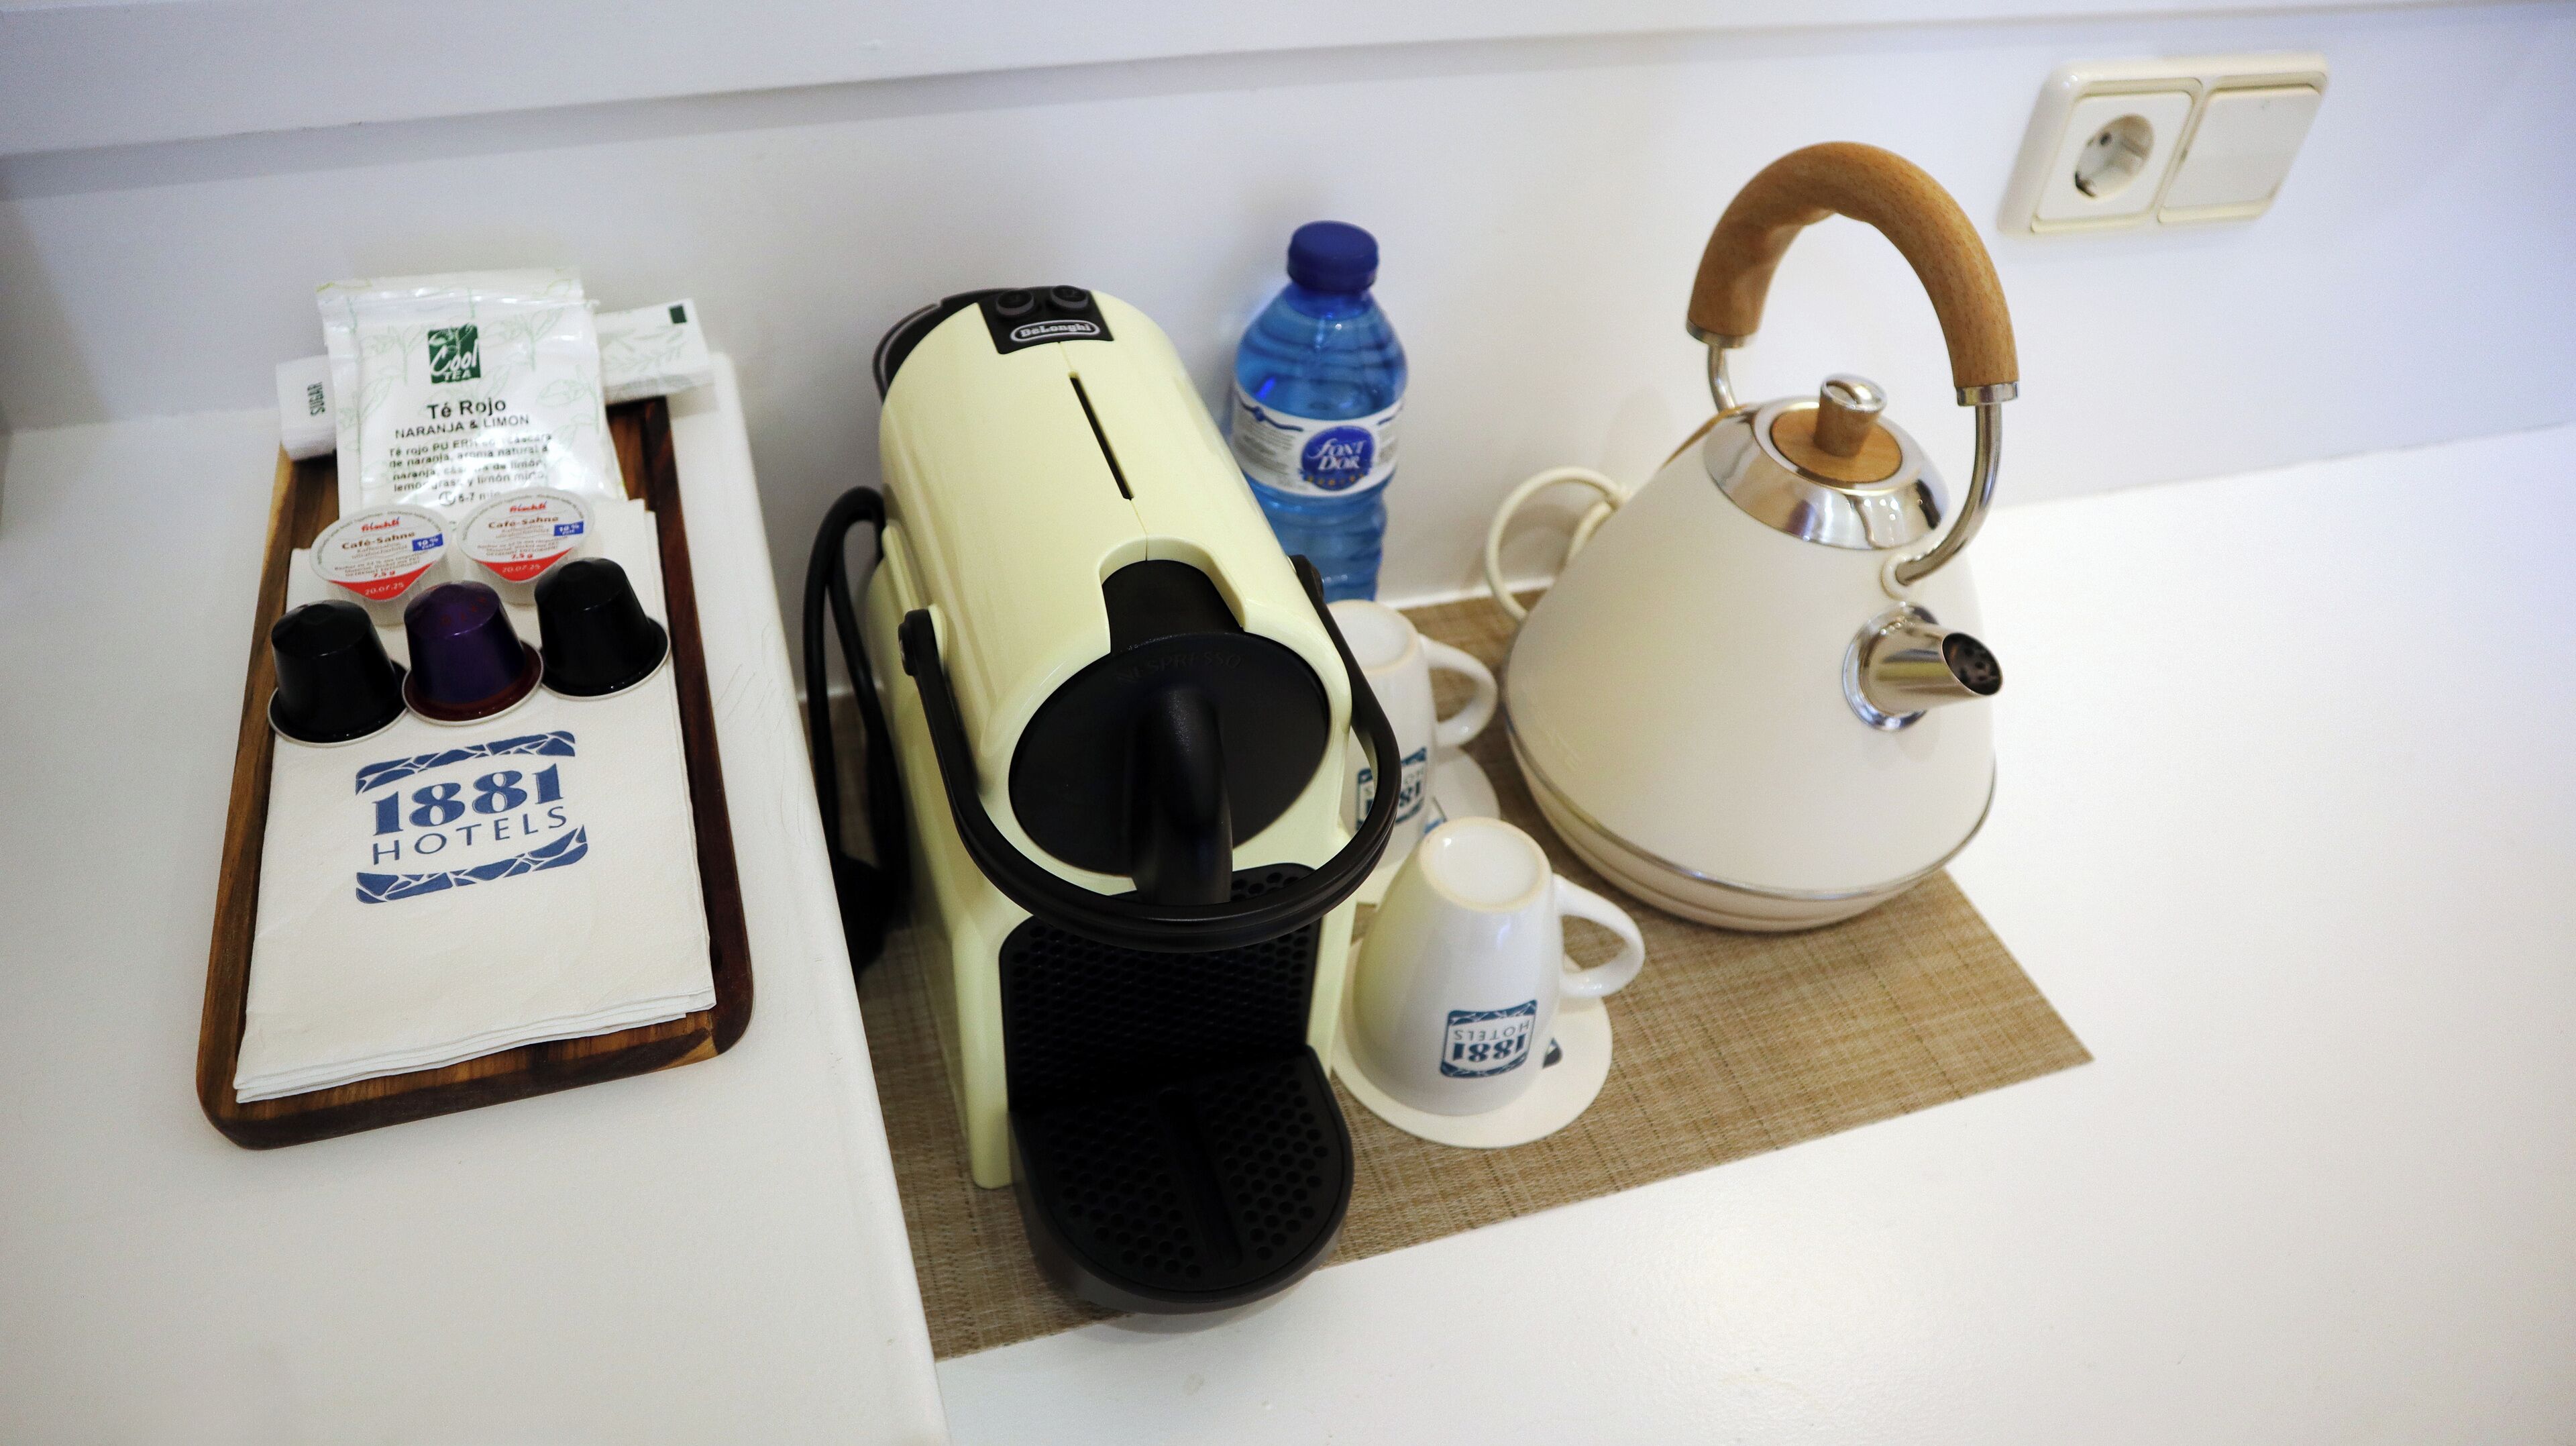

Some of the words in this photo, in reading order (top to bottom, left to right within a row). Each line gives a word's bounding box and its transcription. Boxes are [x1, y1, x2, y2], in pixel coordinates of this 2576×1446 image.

[430, 338, 479, 376] Cool
[443, 370, 472, 380] TEA
[307, 381, 325, 416] SUGAR
[426, 403, 452, 419] Té
[460, 397, 506, 416] Rojo
[394, 422, 464, 439] NARANJA
[470, 421, 478, 429] &
[484, 414, 529, 427] LIMON
[372, 763, 564, 836] 1881
[372, 806, 568, 866] HOTELS
[1454, 1020, 1530, 1041] HOTELS
[1452, 1033, 1527, 1063] 1881
